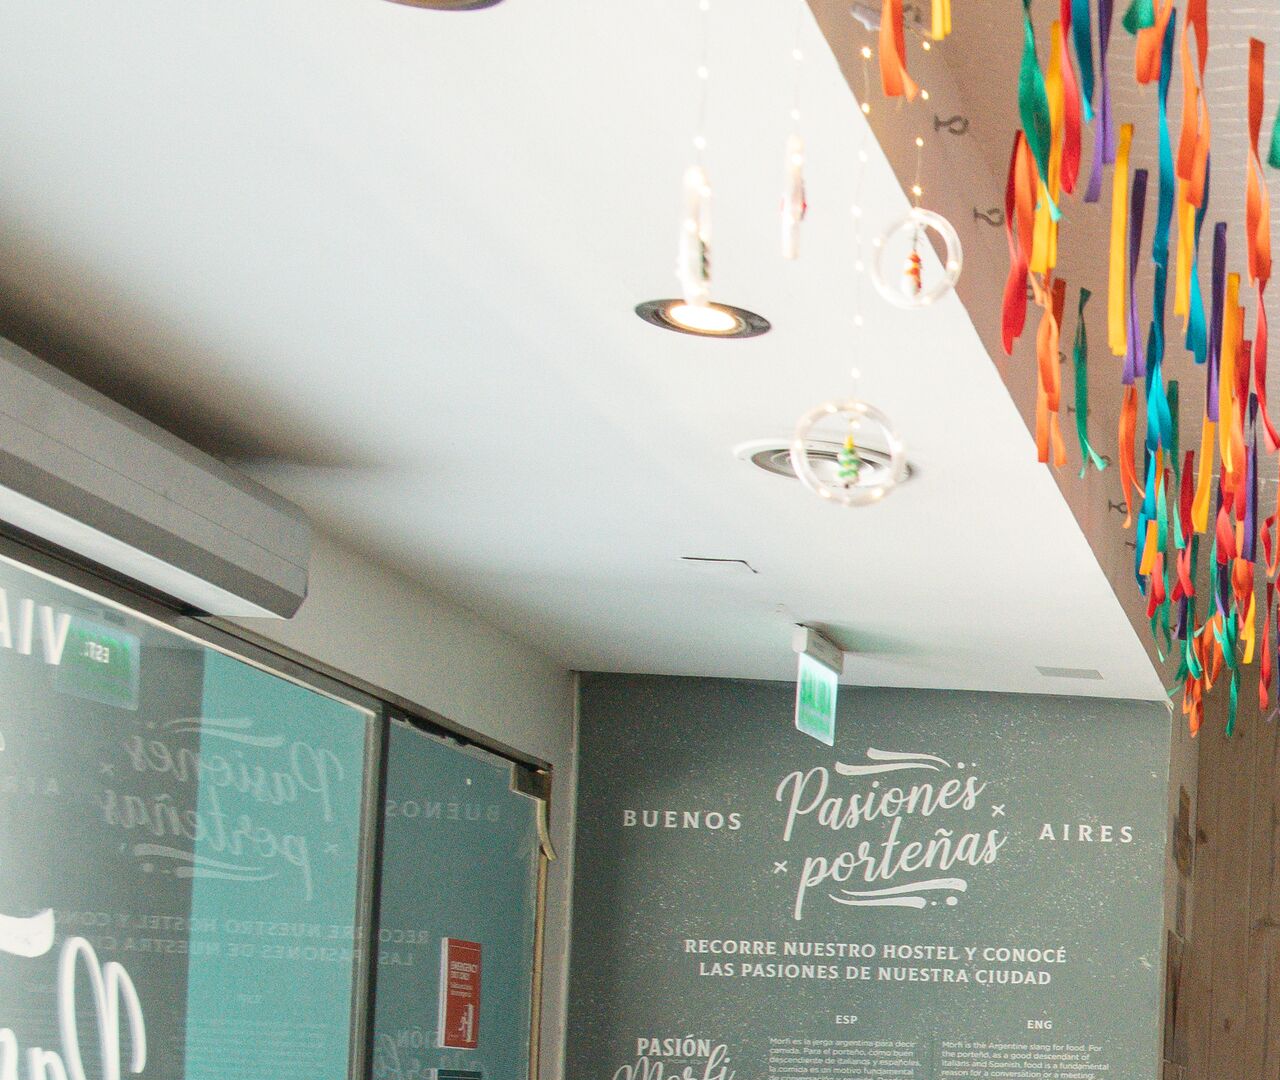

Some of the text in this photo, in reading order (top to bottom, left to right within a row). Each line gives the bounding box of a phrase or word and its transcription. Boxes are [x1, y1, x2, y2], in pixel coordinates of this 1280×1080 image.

[775, 765, 987, 842] Pasiones
[622, 809, 742, 831] BUENOS
[1038, 822, 1134, 844] AIRES
[793, 815, 1008, 921] porteñas
[684, 938, 1067, 964] RECORRE NUESTRO HOSTEL Y CONOCÉ
[699, 961, 1052, 985] LAS PASIONES DE NUESTRA CIUDAD
[835, 1014, 858, 1025] ESP
[1026, 1019, 1053, 1030] ENG
[636, 1033, 711, 1057] PASIÓN
